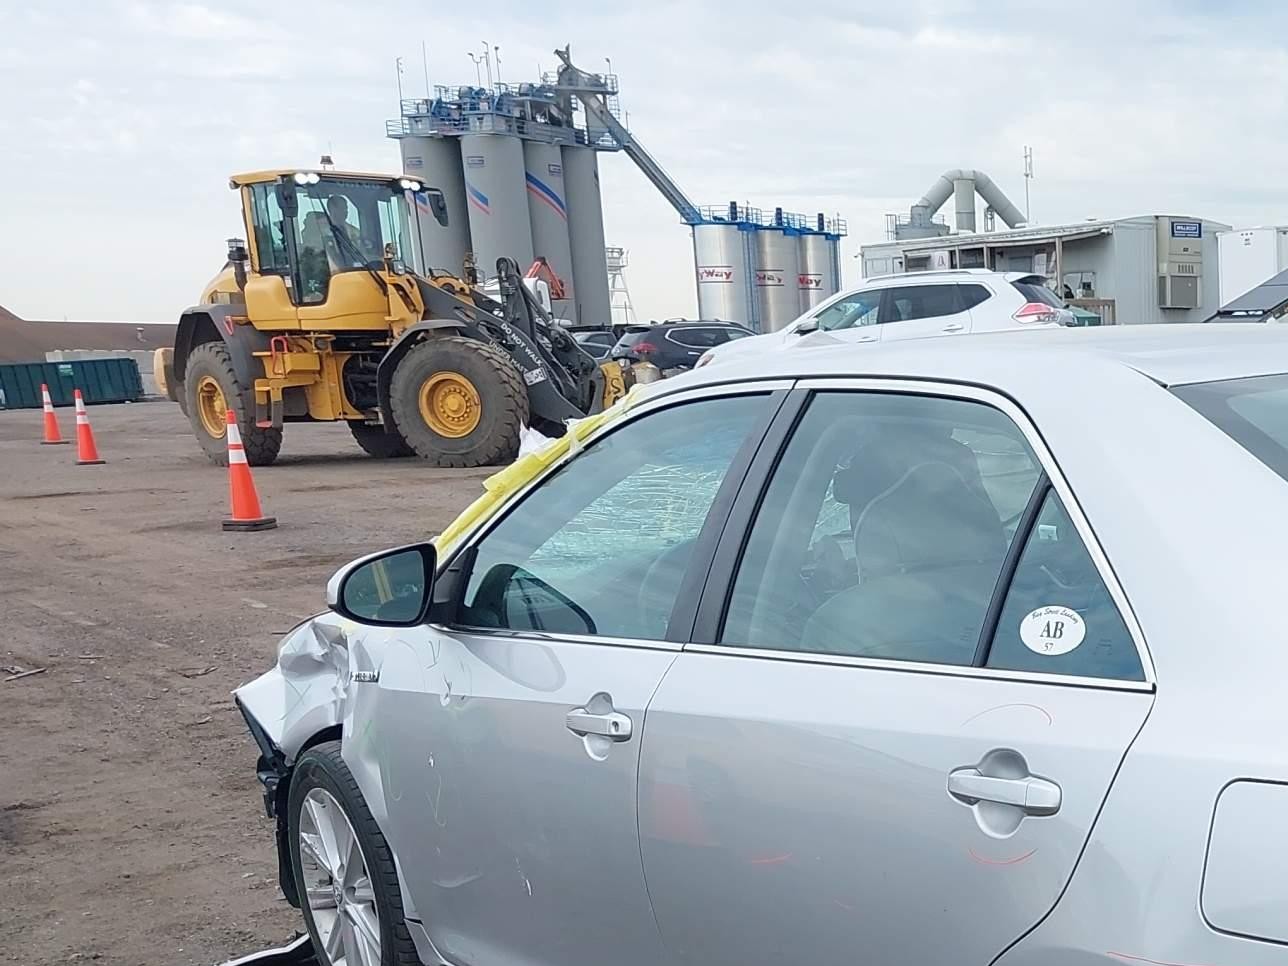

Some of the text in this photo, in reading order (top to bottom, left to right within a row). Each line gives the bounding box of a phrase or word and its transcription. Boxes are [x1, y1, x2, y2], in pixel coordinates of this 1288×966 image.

[500, 322, 512, 335] DO
[511, 332, 526, 348] NOT
[524, 346, 543, 367] WALK
[1039, 619, 1065, 639] AB
